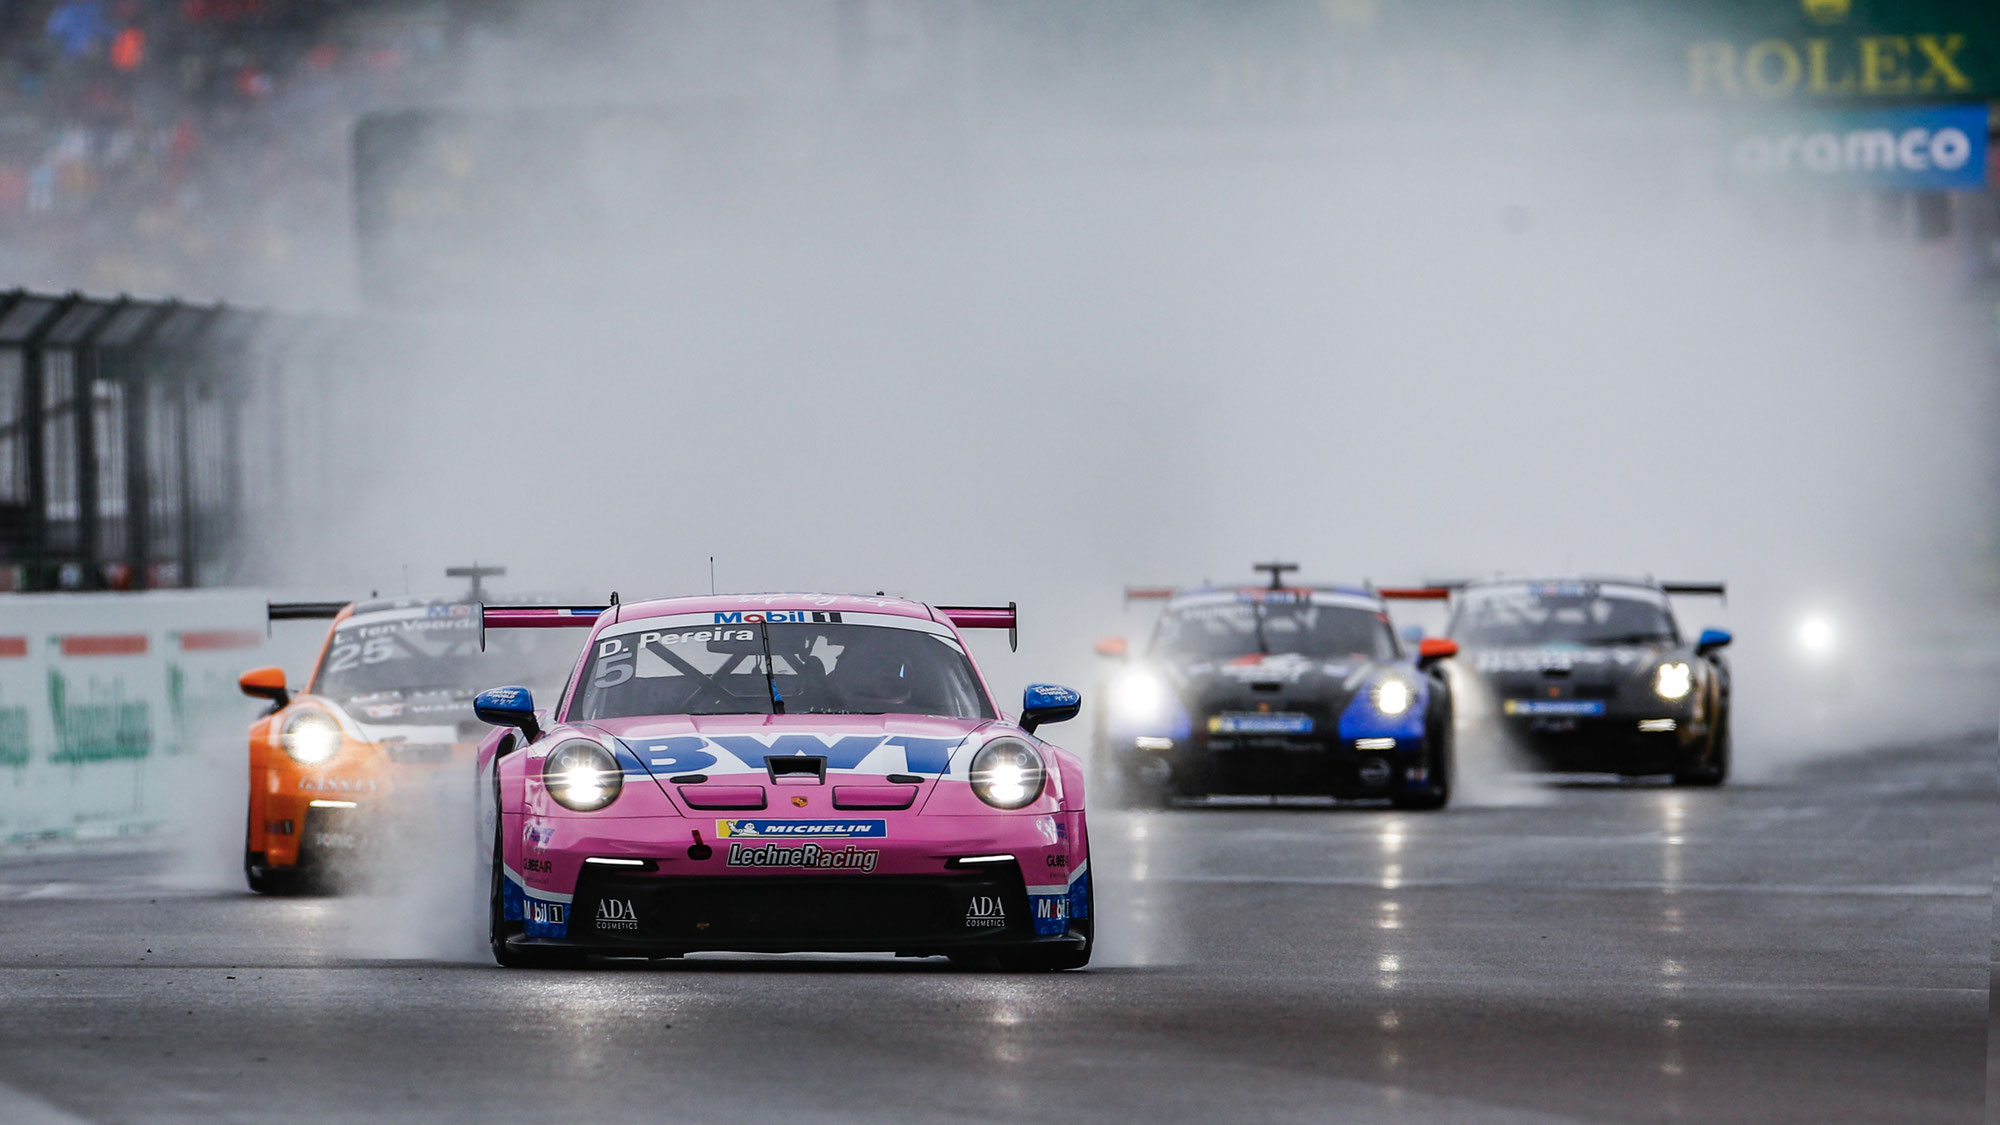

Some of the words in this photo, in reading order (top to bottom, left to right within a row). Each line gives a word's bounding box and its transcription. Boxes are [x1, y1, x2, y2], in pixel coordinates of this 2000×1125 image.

[1686, 35, 1972, 97] ROLEX
[1736, 127, 1971, 172] aramco
[714, 611, 805, 624] Mobil
[358, 623, 397, 640] ten
[598, 638, 630, 659] D.
[638, 627, 754, 650] Pereira
[328, 636, 395, 674] 25
[593, 651, 634, 689] 5
[614, 734, 970, 775] BWT
[764, 824, 873, 833] MICHELIN
[523, 900, 547, 924] Mobil
[596, 898, 638, 919] ADA
[966, 896, 1005, 916] ADA
[596, 921, 638, 930] COSMETICS
